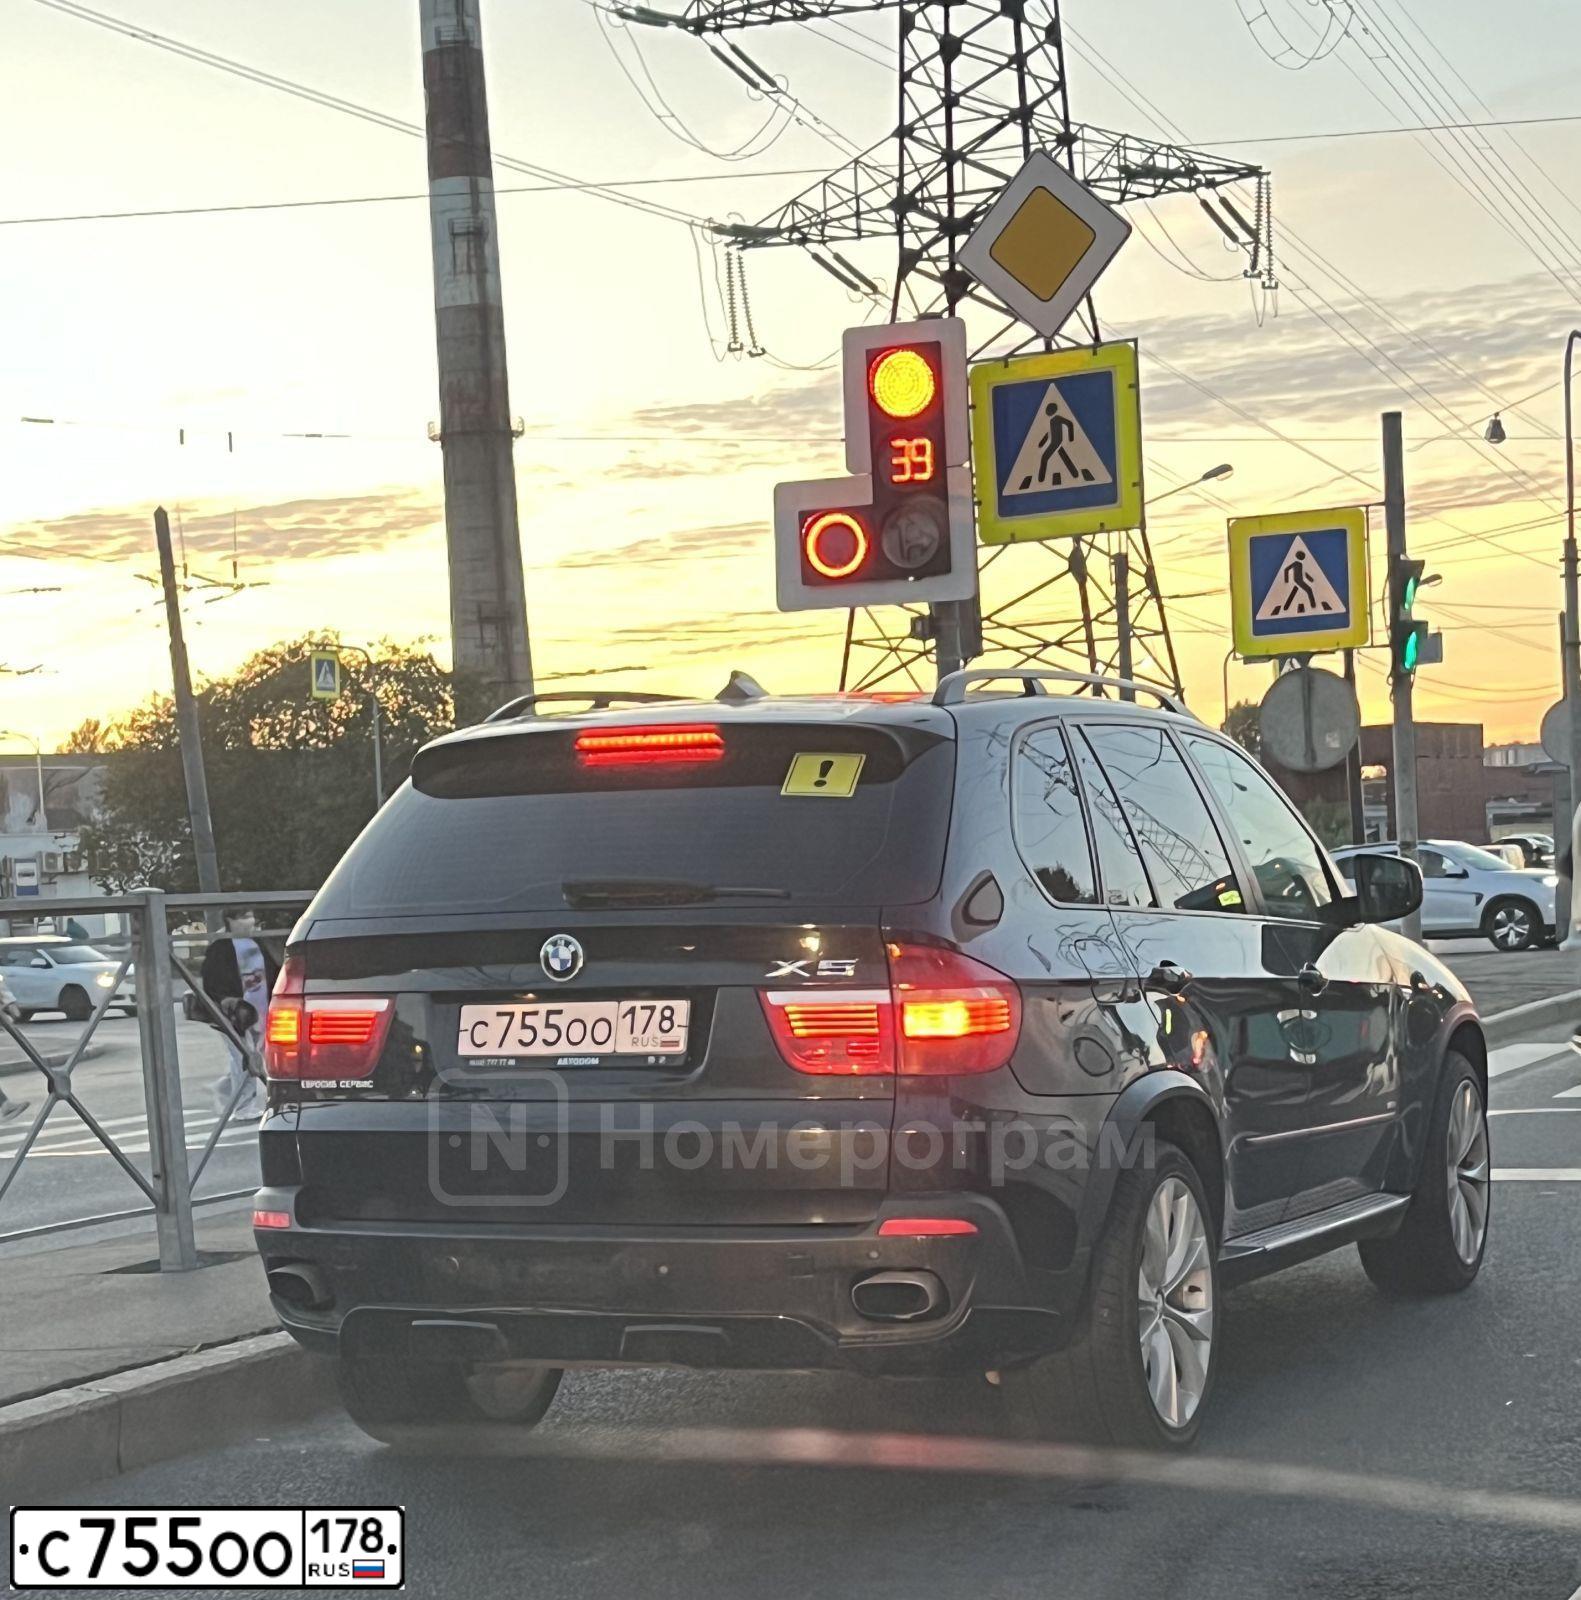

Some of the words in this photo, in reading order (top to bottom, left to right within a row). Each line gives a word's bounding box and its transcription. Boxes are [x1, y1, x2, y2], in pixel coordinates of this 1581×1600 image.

[890, 438, 934, 482] 39
[765, 959, 858, 976] X5
[622, 1004, 675, 1035] 178
[631, 1036, 659, 1048] RUS
